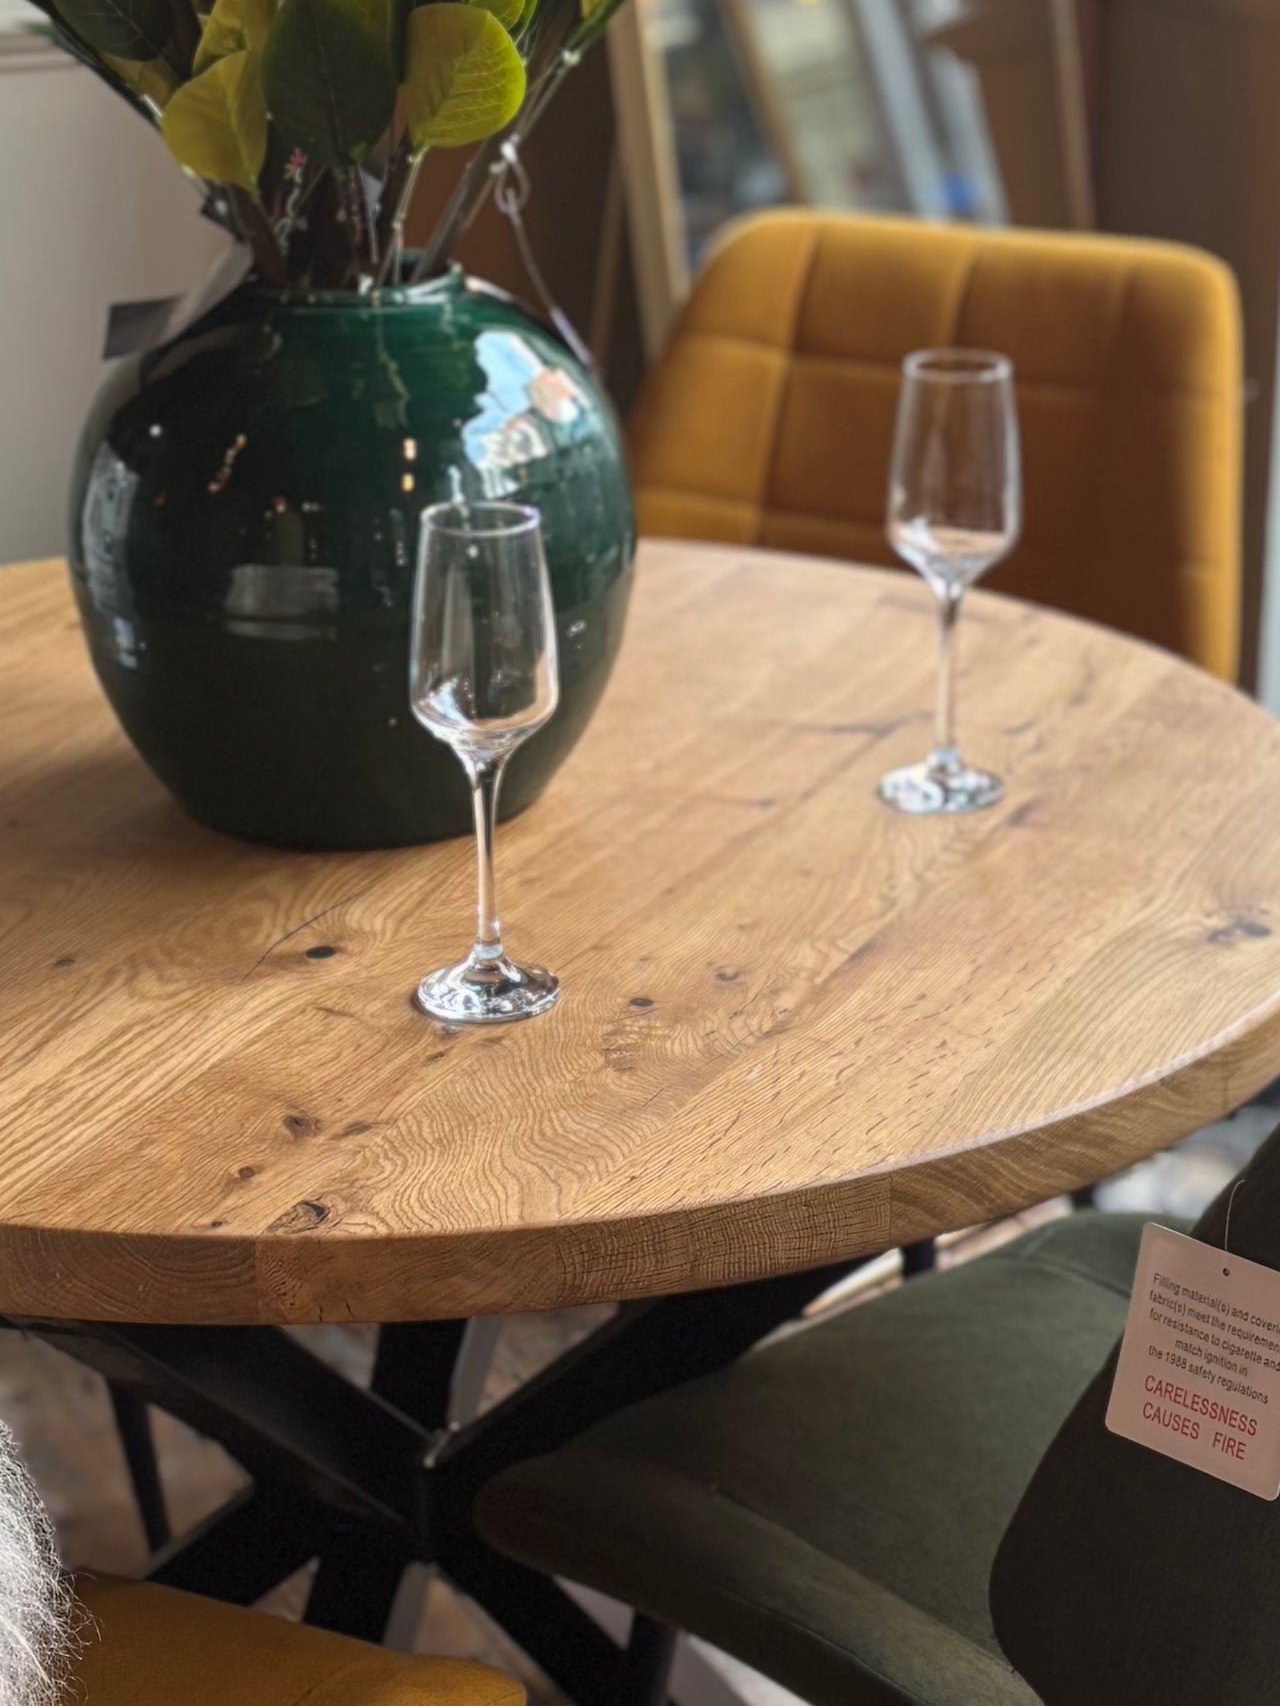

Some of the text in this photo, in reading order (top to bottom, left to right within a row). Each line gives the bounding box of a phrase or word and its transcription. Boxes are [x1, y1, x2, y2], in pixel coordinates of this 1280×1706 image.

[1149, 1289, 1186, 1316] fabric(s)
[1187, 1307, 1210, 1325] meet
[1211, 1315, 1226, 1331] the
[1153, 1273, 1181, 1296] Filling
[1182, 1287, 1230, 1316] material(s)
[1231, 1307, 1249, 1322] and
[1150, 1307, 1280, 1372] for resistance to cigarette and
[1175, 1339, 1248, 1377] match ignition in
[1148, 1345, 1268, 1405] the 1988 safety regulations
[1142, 1401, 1246, 1460] CAUSES FIRE
[1144, 1374, 1257, 1436] CARELESSNESS
